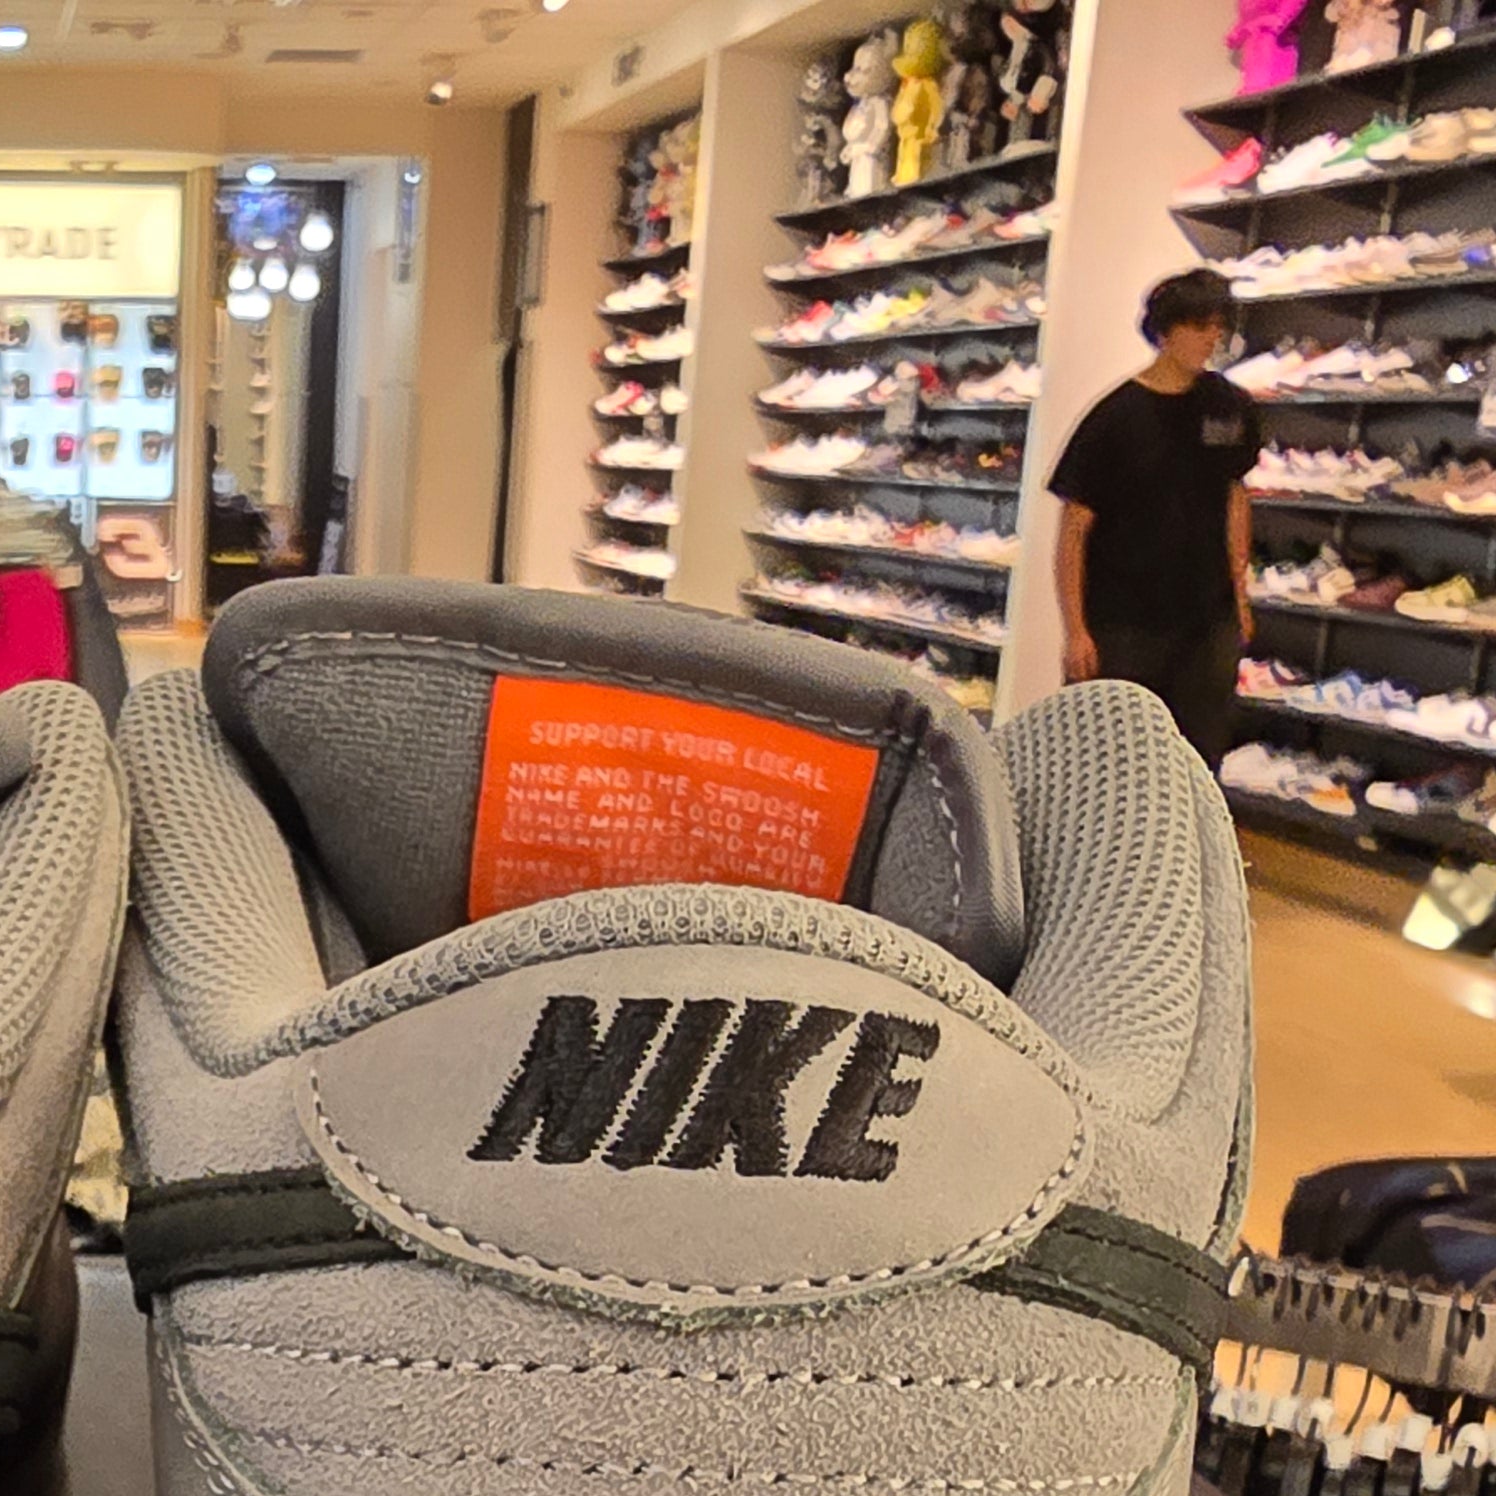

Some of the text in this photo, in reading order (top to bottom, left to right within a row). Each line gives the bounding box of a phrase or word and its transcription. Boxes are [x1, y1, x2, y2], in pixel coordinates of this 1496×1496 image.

[529, 720, 830, 793] SUPPORT YOUR LOCAL
[505, 786, 813, 849] NAME AND LOGO ARE
[508, 762, 821, 828] NIKE AND THE SWOOSH
[690, 826, 744, 853] AND
[466, 995, 941, 1182] NIKE
